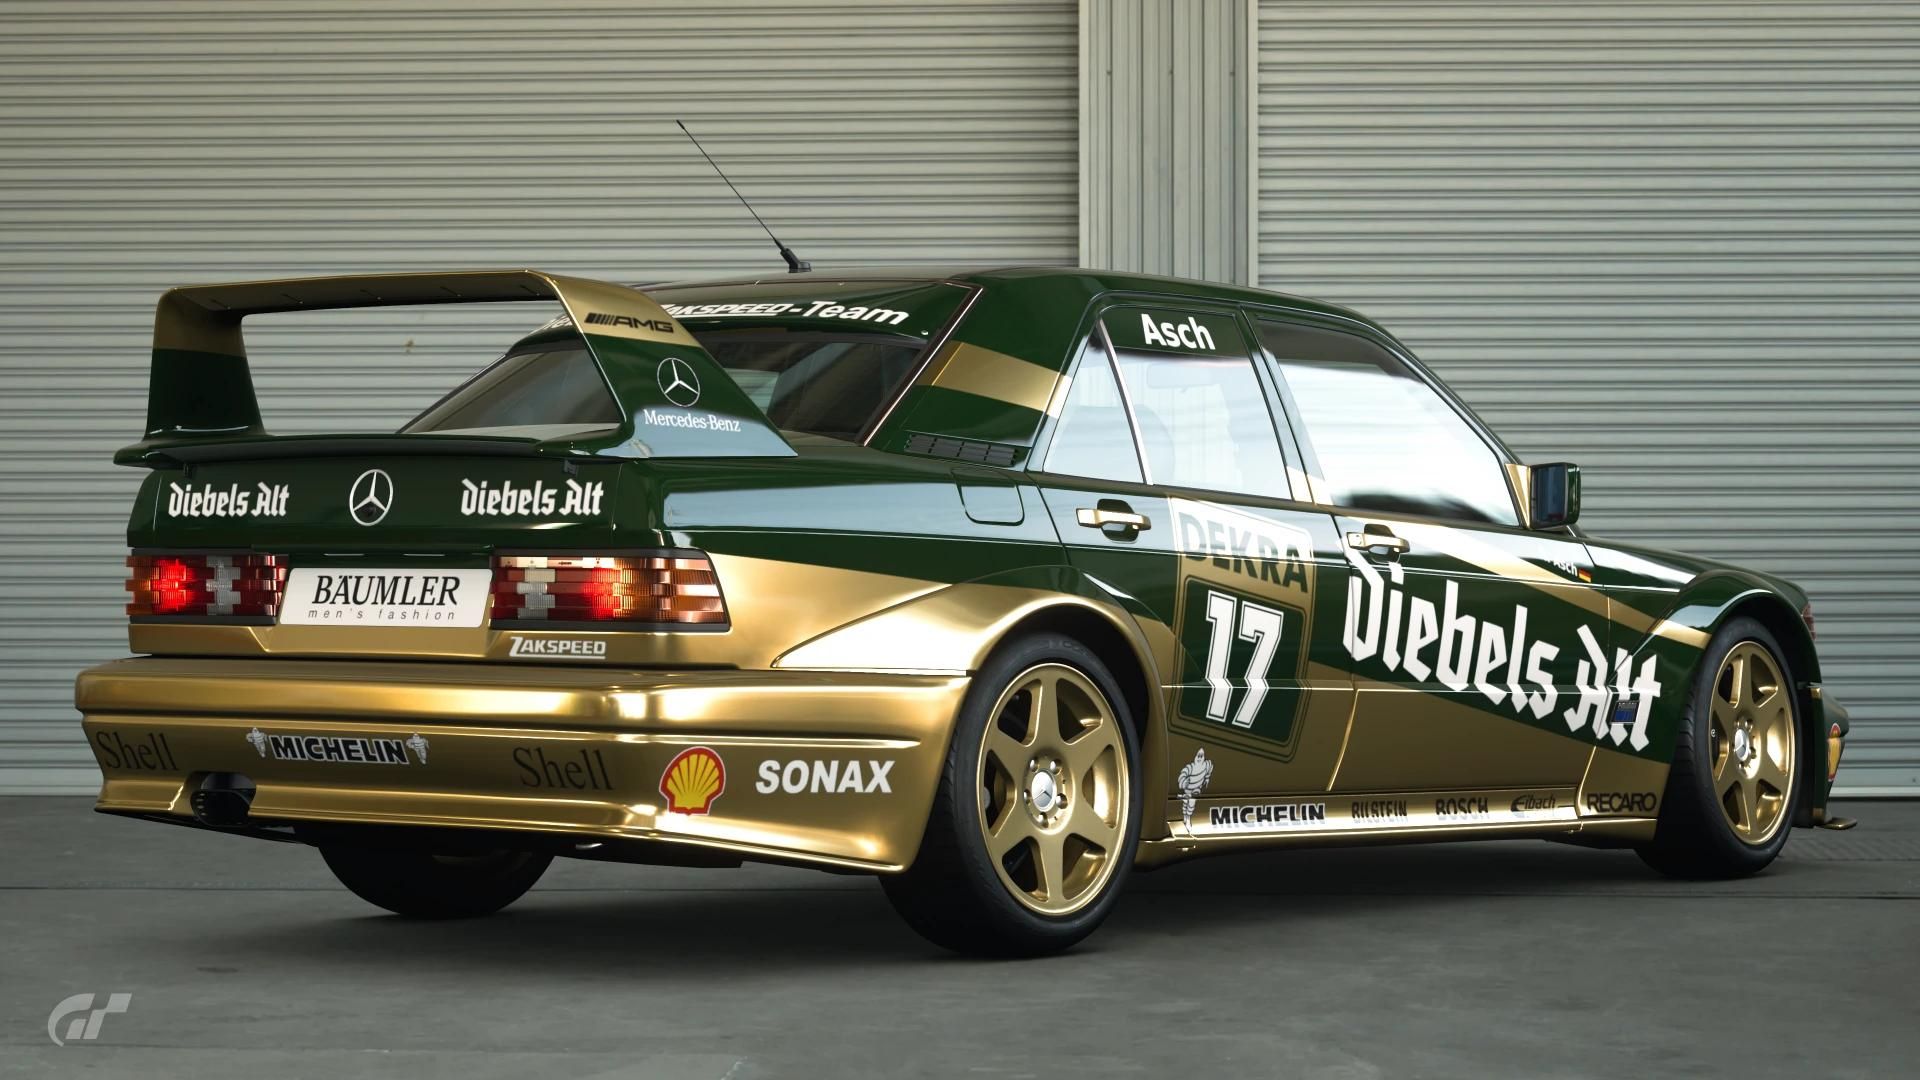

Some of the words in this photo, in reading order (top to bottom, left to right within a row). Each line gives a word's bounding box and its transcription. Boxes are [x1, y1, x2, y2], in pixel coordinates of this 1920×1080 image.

[611, 315, 674, 334] AMG
[1140, 313, 1216, 351] Asch
[642, 408, 742, 433] Mercedes-Benz
[250, 481, 290, 518] Alt
[558, 478, 605, 517] Alt
[1178, 511, 1309, 594] DEKRA
[311, 575, 461, 607] BÄUMLER
[308, 608, 364, 620] men's
[378, 609, 456, 621] fashion
[509, 636, 607, 660] ZAKSPEED
[1205, 589, 1285, 729] 17
[1563, 623, 1662, 753] Alt
[95, 730, 181, 773] Shell
[268, 733, 411, 765] MICHELIN
[511, 747, 615, 792] Shell
[755, 759, 896, 795] SONAX
[1209, 803, 1326, 828] MICHELIN
[1434, 797, 1490, 820] BOSCH
[1510, 793, 1556, 815] Eibach
[1586, 791, 1658, 813] RECARO
